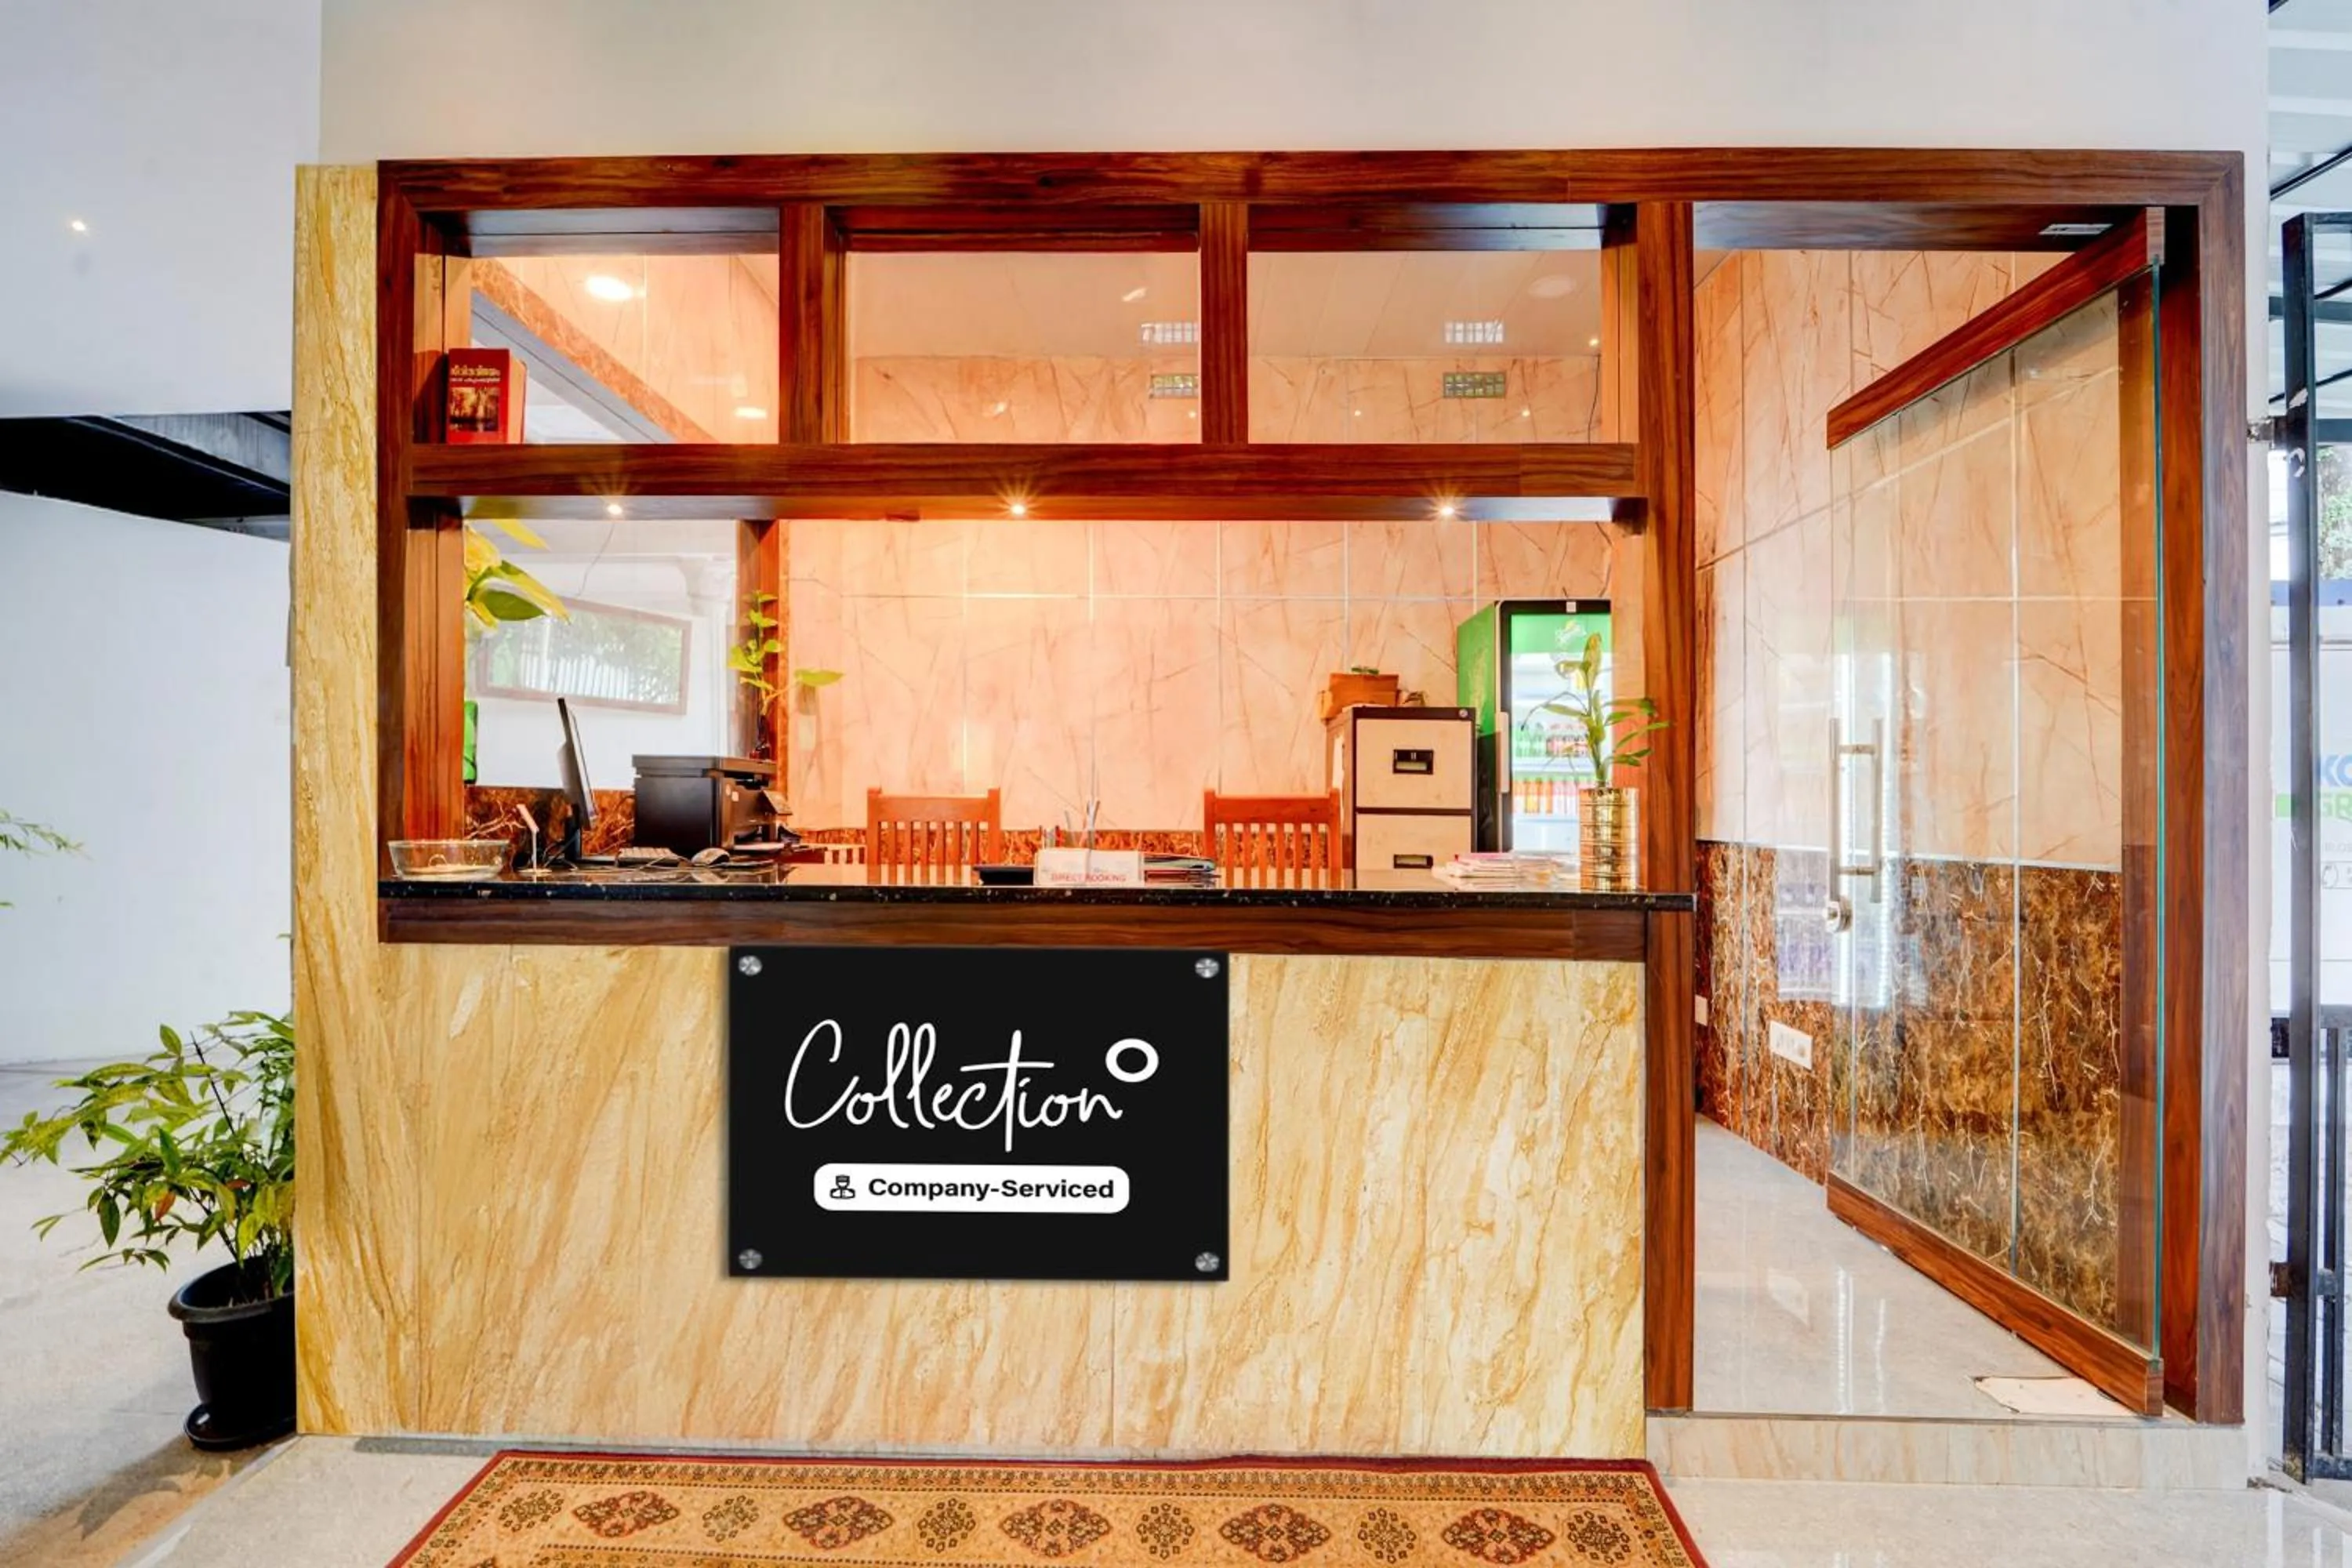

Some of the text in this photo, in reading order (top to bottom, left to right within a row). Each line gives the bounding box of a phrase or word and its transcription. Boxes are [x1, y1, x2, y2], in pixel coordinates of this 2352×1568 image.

[1085, 873, 1127, 883] BOOKING
[784, 1018, 1123, 1152] Collection
[868, 1178, 1115, 1202] Company-Serviced
